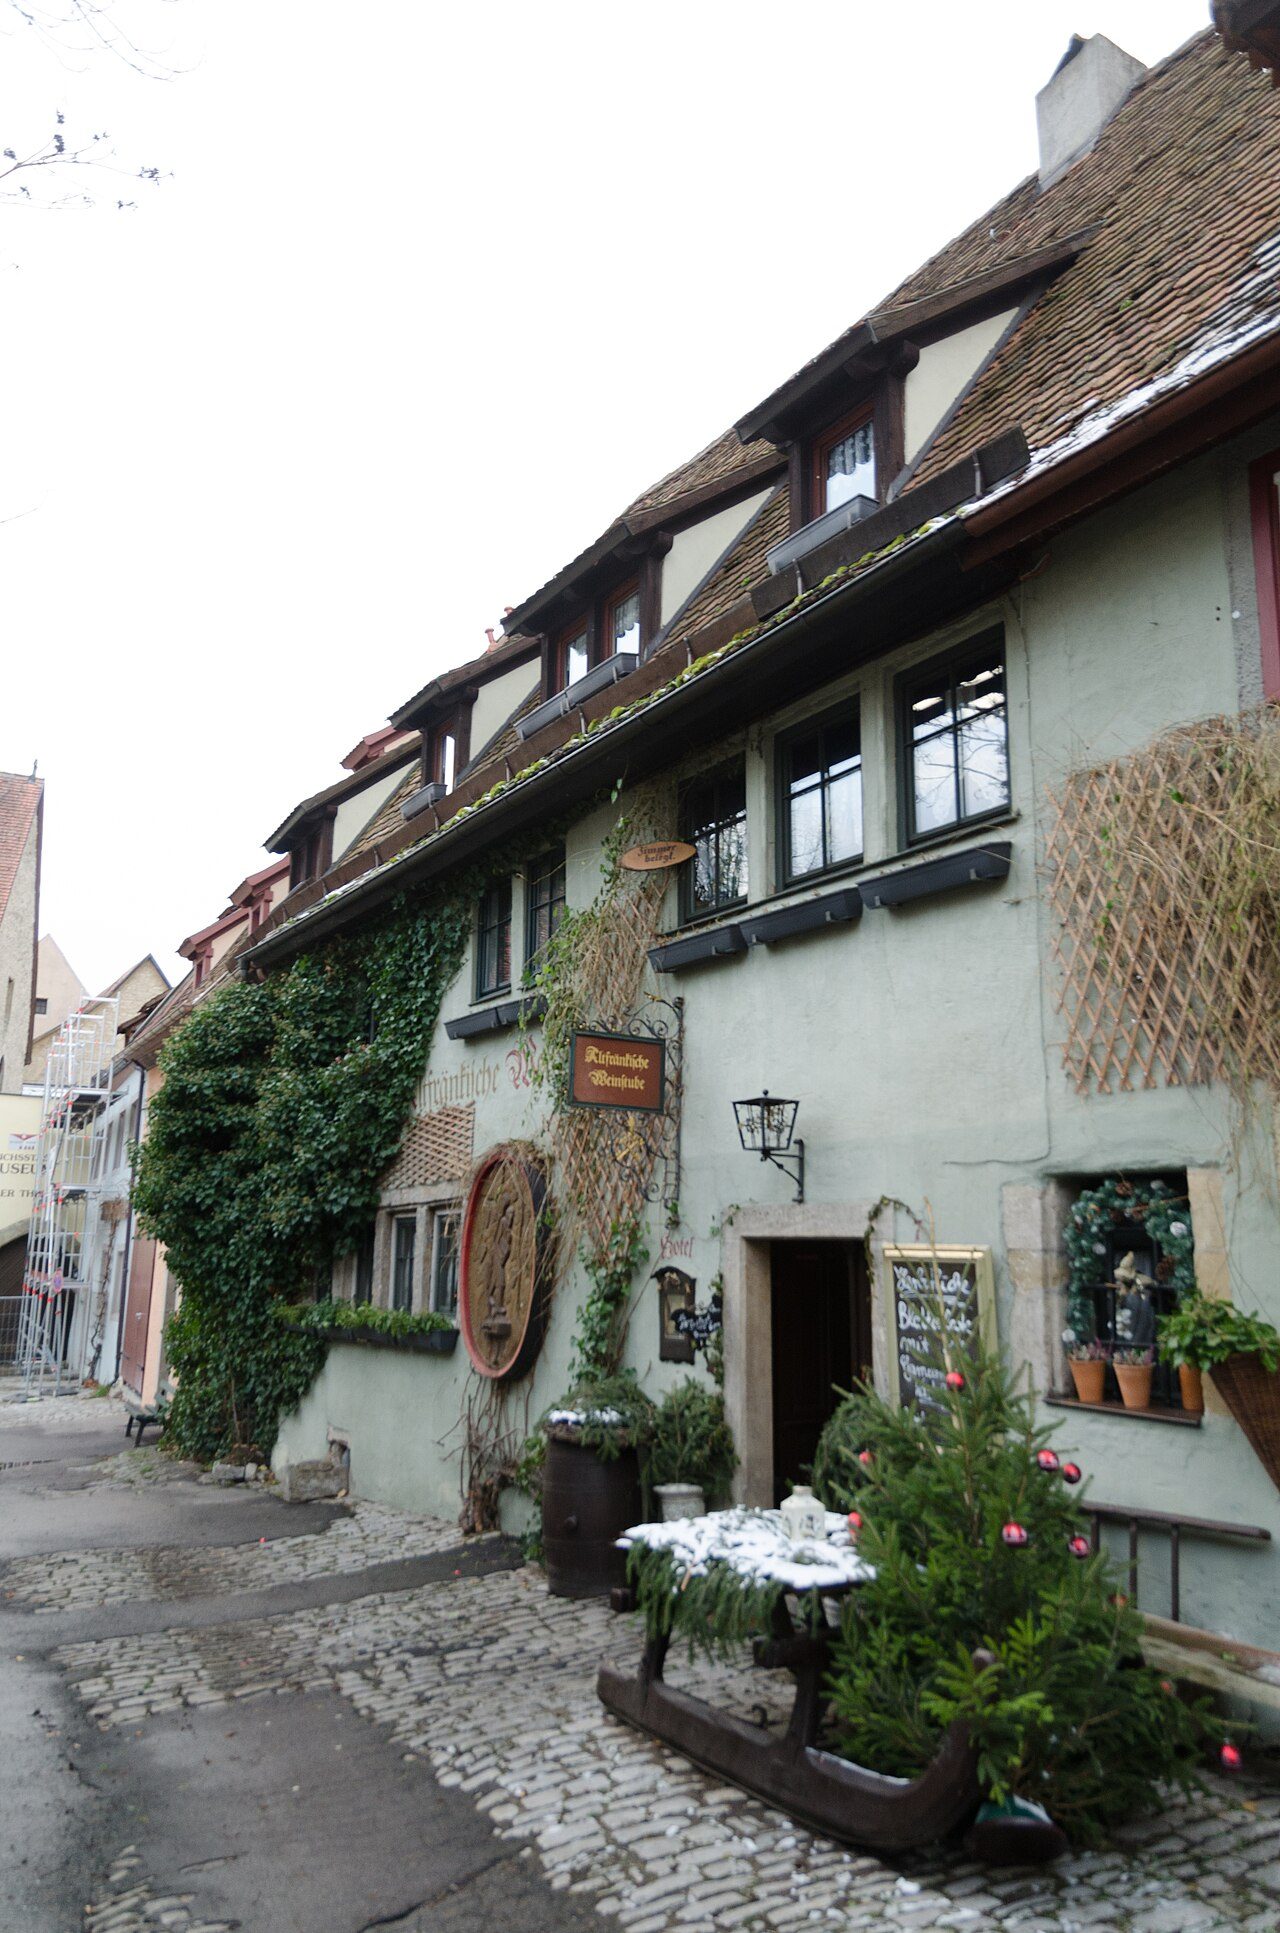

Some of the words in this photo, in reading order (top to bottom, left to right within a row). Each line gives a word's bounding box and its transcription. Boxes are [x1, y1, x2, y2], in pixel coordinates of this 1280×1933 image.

[638, 845, 677, 857] Zimmer
[584, 1045, 650, 1071] Altfränkische
[588, 1069, 646, 1091] Weinstube
[660, 1235, 695, 1260] Hotel
